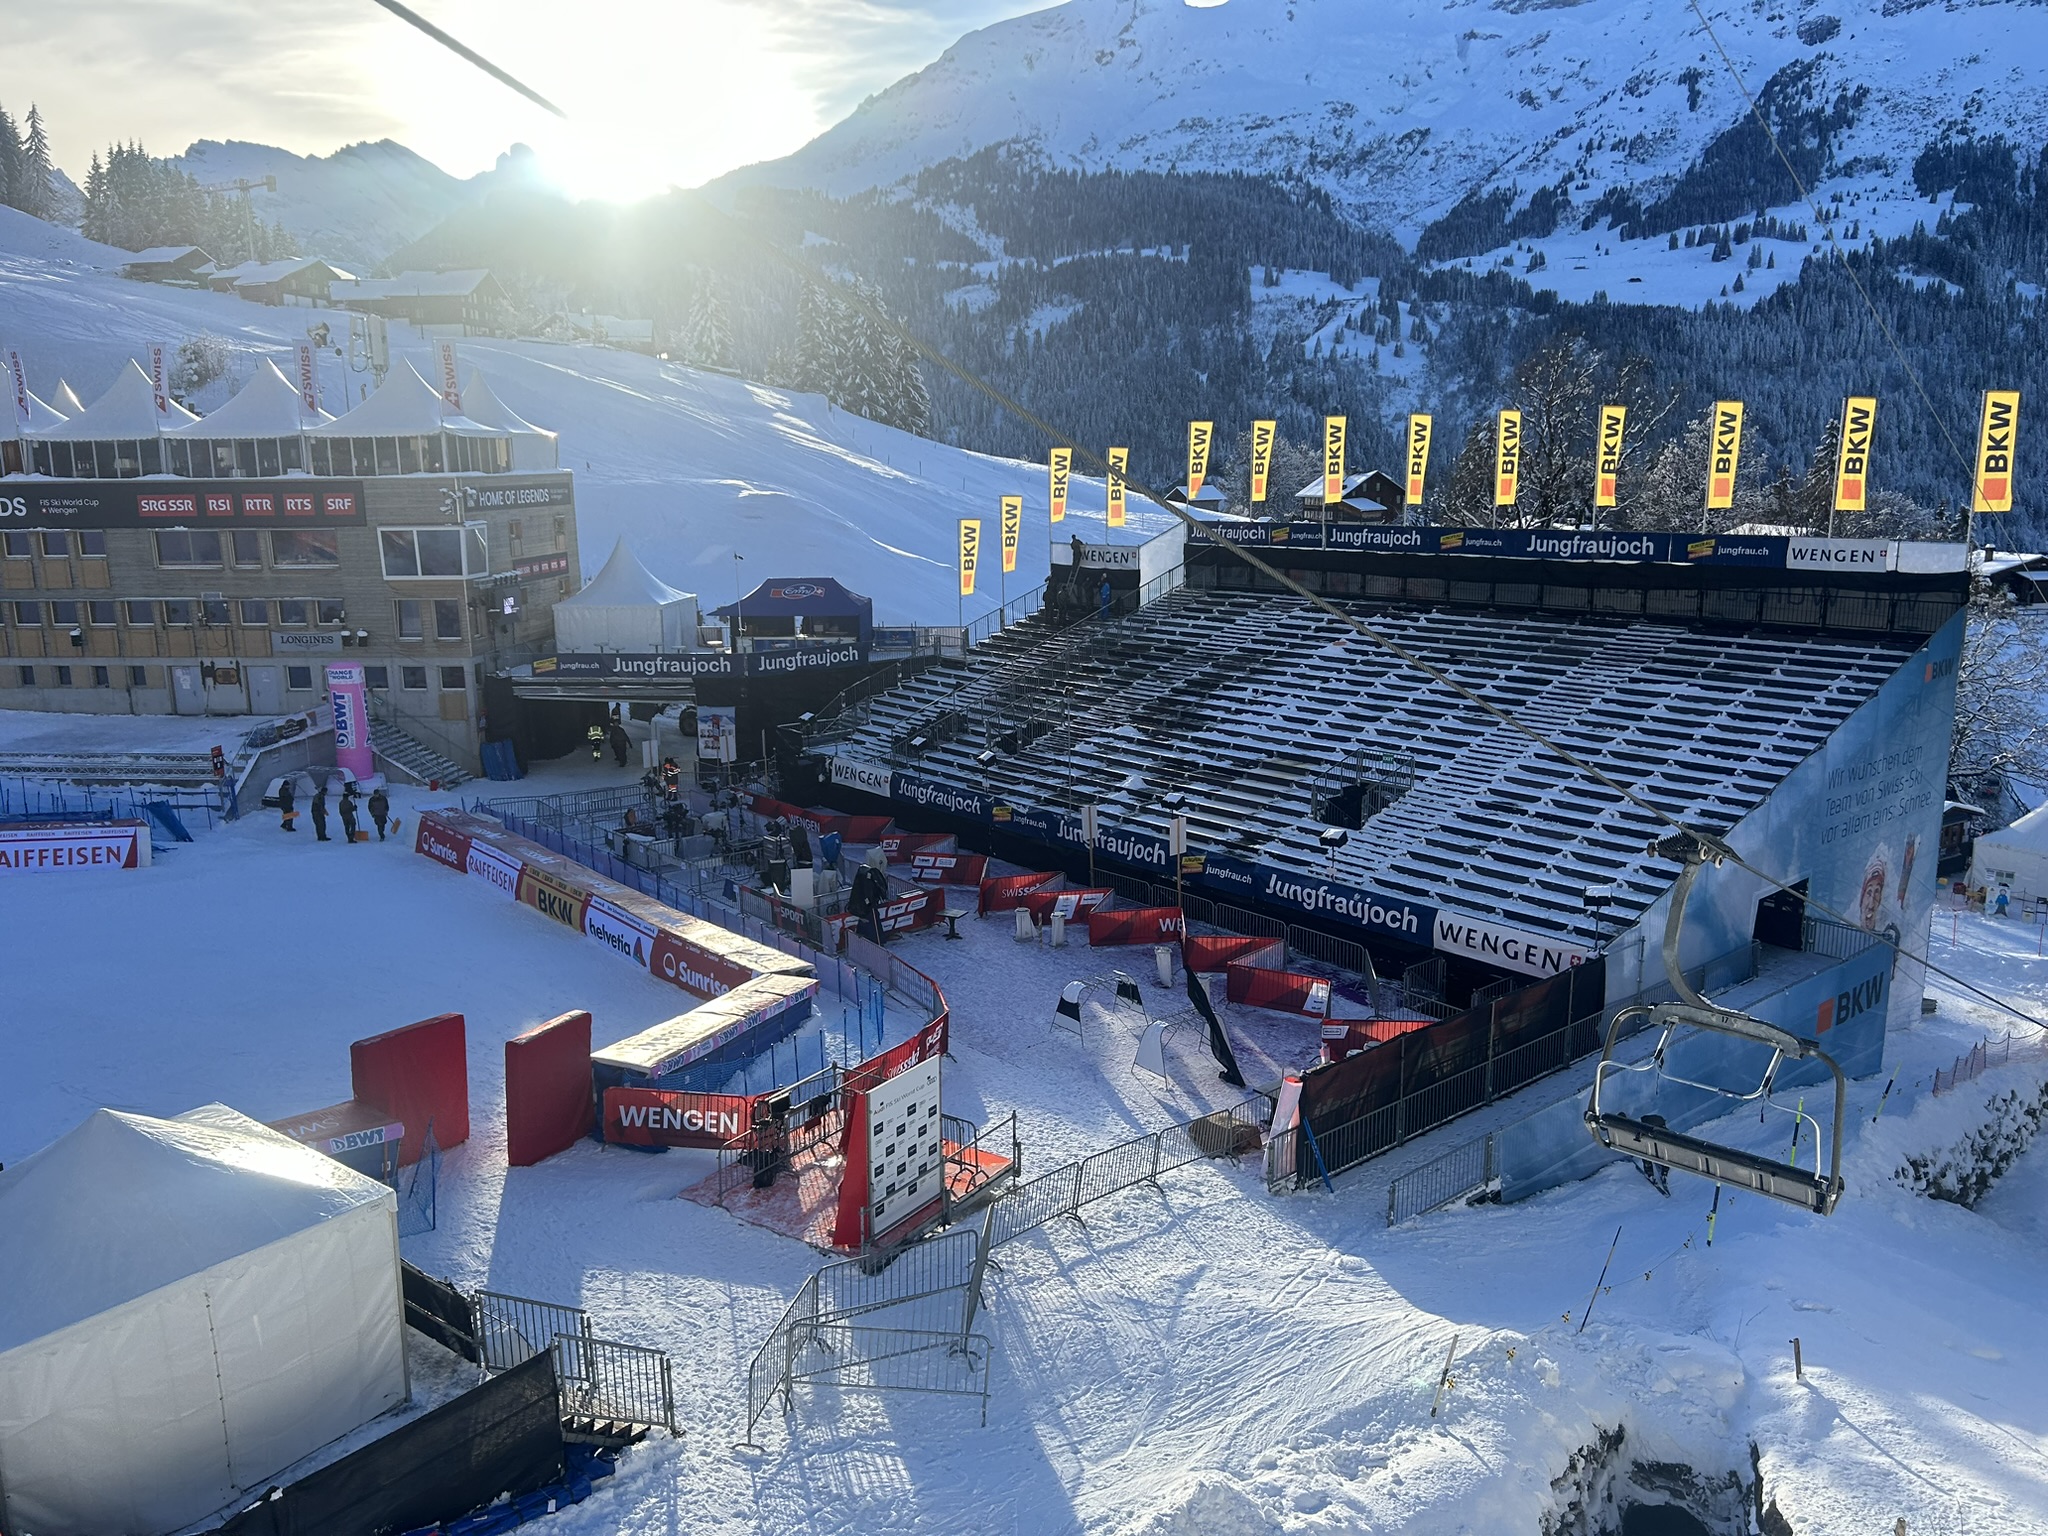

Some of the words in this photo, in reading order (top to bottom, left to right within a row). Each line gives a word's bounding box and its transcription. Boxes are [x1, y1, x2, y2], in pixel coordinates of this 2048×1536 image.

[153, 347, 163, 392] SWISS
[301, 345, 313, 391] SWISS
[442, 343, 457, 390] SWISS
[1191, 427, 1208, 475] BKW
[1254, 426, 1271, 475] BKW
[1328, 424, 1343, 475] BKW
[1411, 421, 1428, 476] BKW
[1501, 418, 1518, 475] BKW
[1602, 414, 1621, 474] BKW
[1715, 411, 1737, 473] BKW
[1844, 406, 1870, 474] BKW
[1985, 401, 2012, 473] BKW
[1053, 454, 1068, 499] BKW
[1111, 454, 1124, 501] BKW
[0, 497, 27, 516] DS
[47, 507, 78, 516] Wengen
[83, 499, 99, 507] Cup
[141, 499, 167, 511] SRG
[168, 499, 194, 511] SSR
[208, 499, 230, 511] RSI
[245, 499, 272, 511] RTR
[287, 498, 312, 510] RTS
[327, 498, 352, 510] SRF
[479, 491, 504, 507] HOME
[504, 489, 515, 505] OF
[516, 488, 550, 504] LEGENDS
[1005, 502, 1018, 548] BKW
[1330, 528, 1421, 548] Jungfraujoch
[963, 526, 977, 571] BKW
[1465, 537, 1502, 547] jungfrau.ch
[1526, 534, 1654, 558] Jungfraujoch
[1718, 545, 1769, 556] jungfrau.ch
[1791, 547, 1875, 563] WENGEN
[280, 635, 334, 645] LONGINES
[560, 662, 600, 671] jungfrau.ch
[613, 656, 731, 676] Jungfraujoch
[758, 646, 858, 671] Jungfraujoch
[1932, 657, 1955, 680] BKW
[333, 691, 348, 731] BWT
[834, 764, 883, 788] WENGEN
[1828, 767, 1845, 790] Wir
[1848, 752, 1900, 783] wünschen
[1902, 745, 1922, 766] dem
[898, 778, 981, 815] Jungfraujoch
[1825, 794, 1852, 818] Team
[1856, 787, 1875, 807] von
[1877, 767, 1923, 800] Swiss-Ski
[788, 812, 820, 833] WENGEN
[1013, 813, 1047, 829] jungfrau.ch
[1821, 825, 1839, 845] vor
[1841, 814, 1870, 839] allem
[1873, 804, 1896, 827] eins:
[1899, 791, 1933, 817] Schnee.
[0, 846, 121, 868] AIFFEISEN
[430, 837, 458, 865] Sunrise
[469, 854, 515, 893] RAIFFEISEN
[1205, 864, 1252, 885] jungfrau.ch
[537, 887, 573, 925] BKW
[780, 906, 804, 926] SPORT
[1265, 873, 1418, 934] Jungfraujoch
[589, 918, 631, 957] helvetia
[1439, 920, 1563, 973] WENGEN
[679, 961, 730, 998] Sunrise
[1835, 971, 1884, 1026] BKW
[1721, 1016, 1729, 1024] 17
[667, 1057, 685, 1072] BWT
[901, 1088, 916, 1100] World
[916, 1084, 925, 1092] Cup
[619, 1105, 738, 1135] WENGEN
[345, 1127, 384, 1150] BWT
